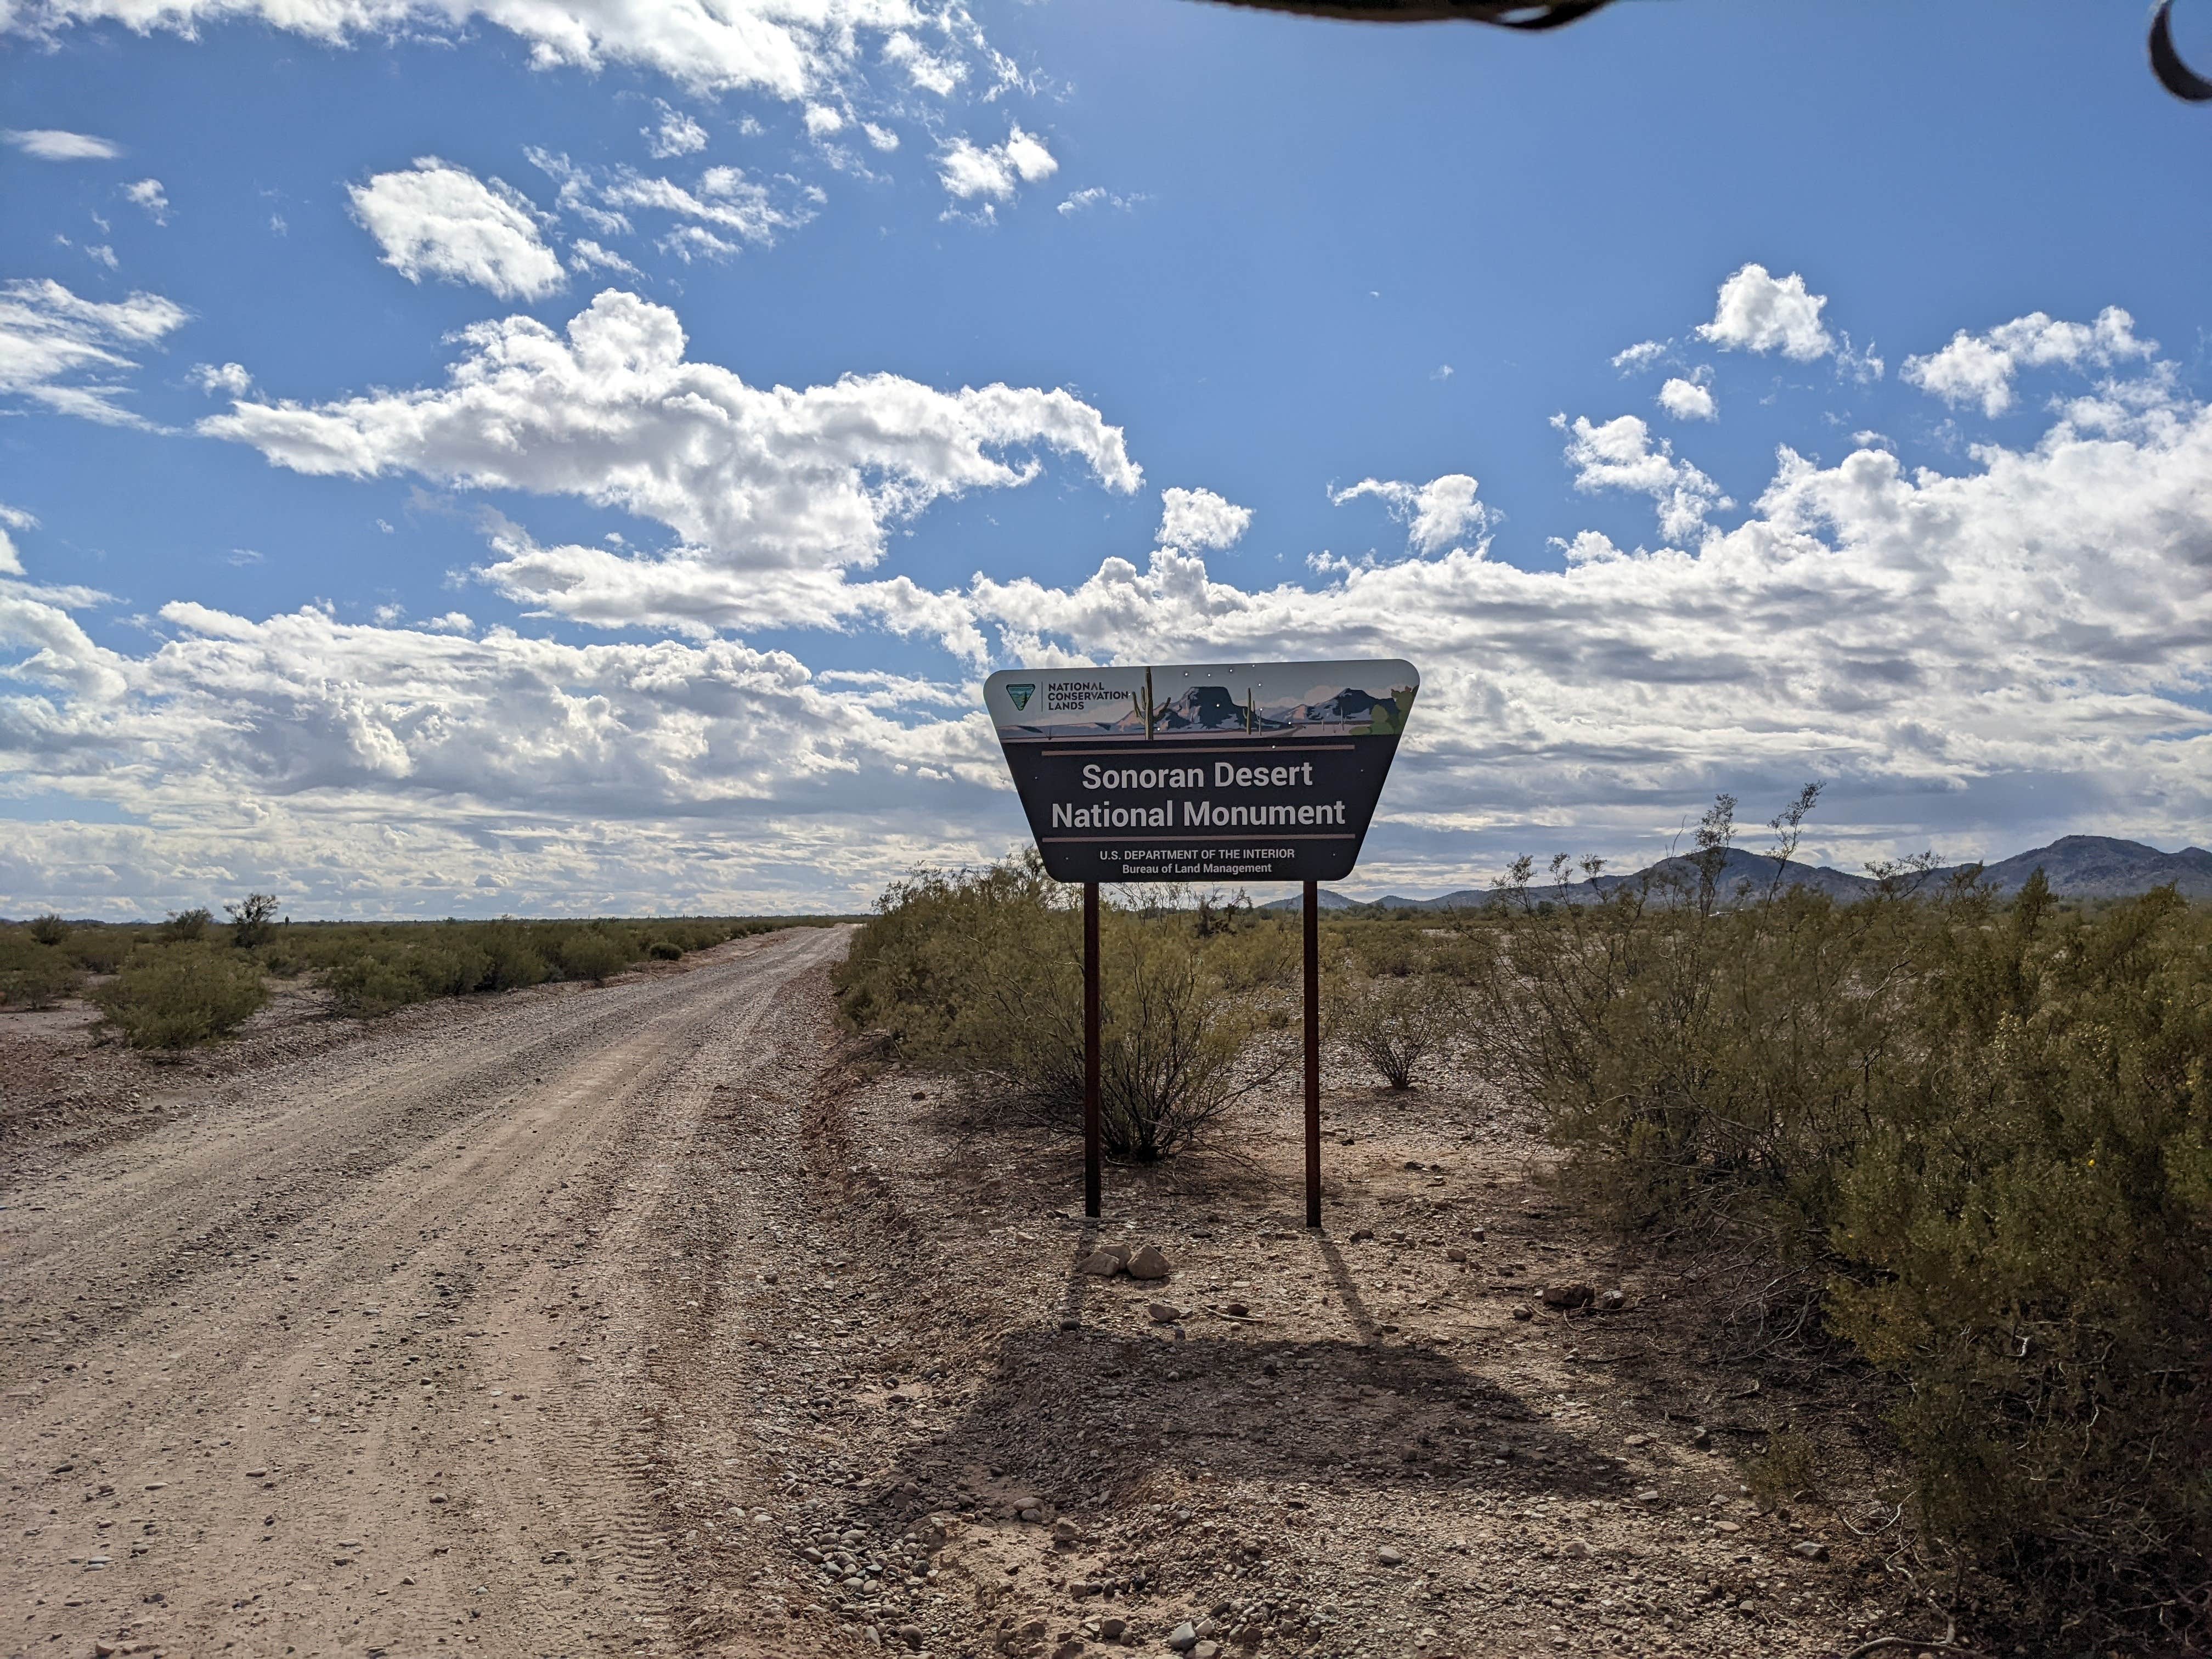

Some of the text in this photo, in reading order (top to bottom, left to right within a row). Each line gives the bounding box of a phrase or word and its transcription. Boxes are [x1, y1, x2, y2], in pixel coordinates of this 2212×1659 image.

[1048, 682, 1104, 691] NATIONAL
[1048, 691, 1128, 701] CONSERVATION
[1048, 701, 1085, 710] LANDS
[1082, 762, 1313, 789] Sonoran Desert
[1052, 800, 1346, 828] National Monument
[1100, 849, 1295, 860] U.S. DEPARTMENT OF THE INTERIOR
[1122, 863, 1272, 875] Bureau of Land Management
